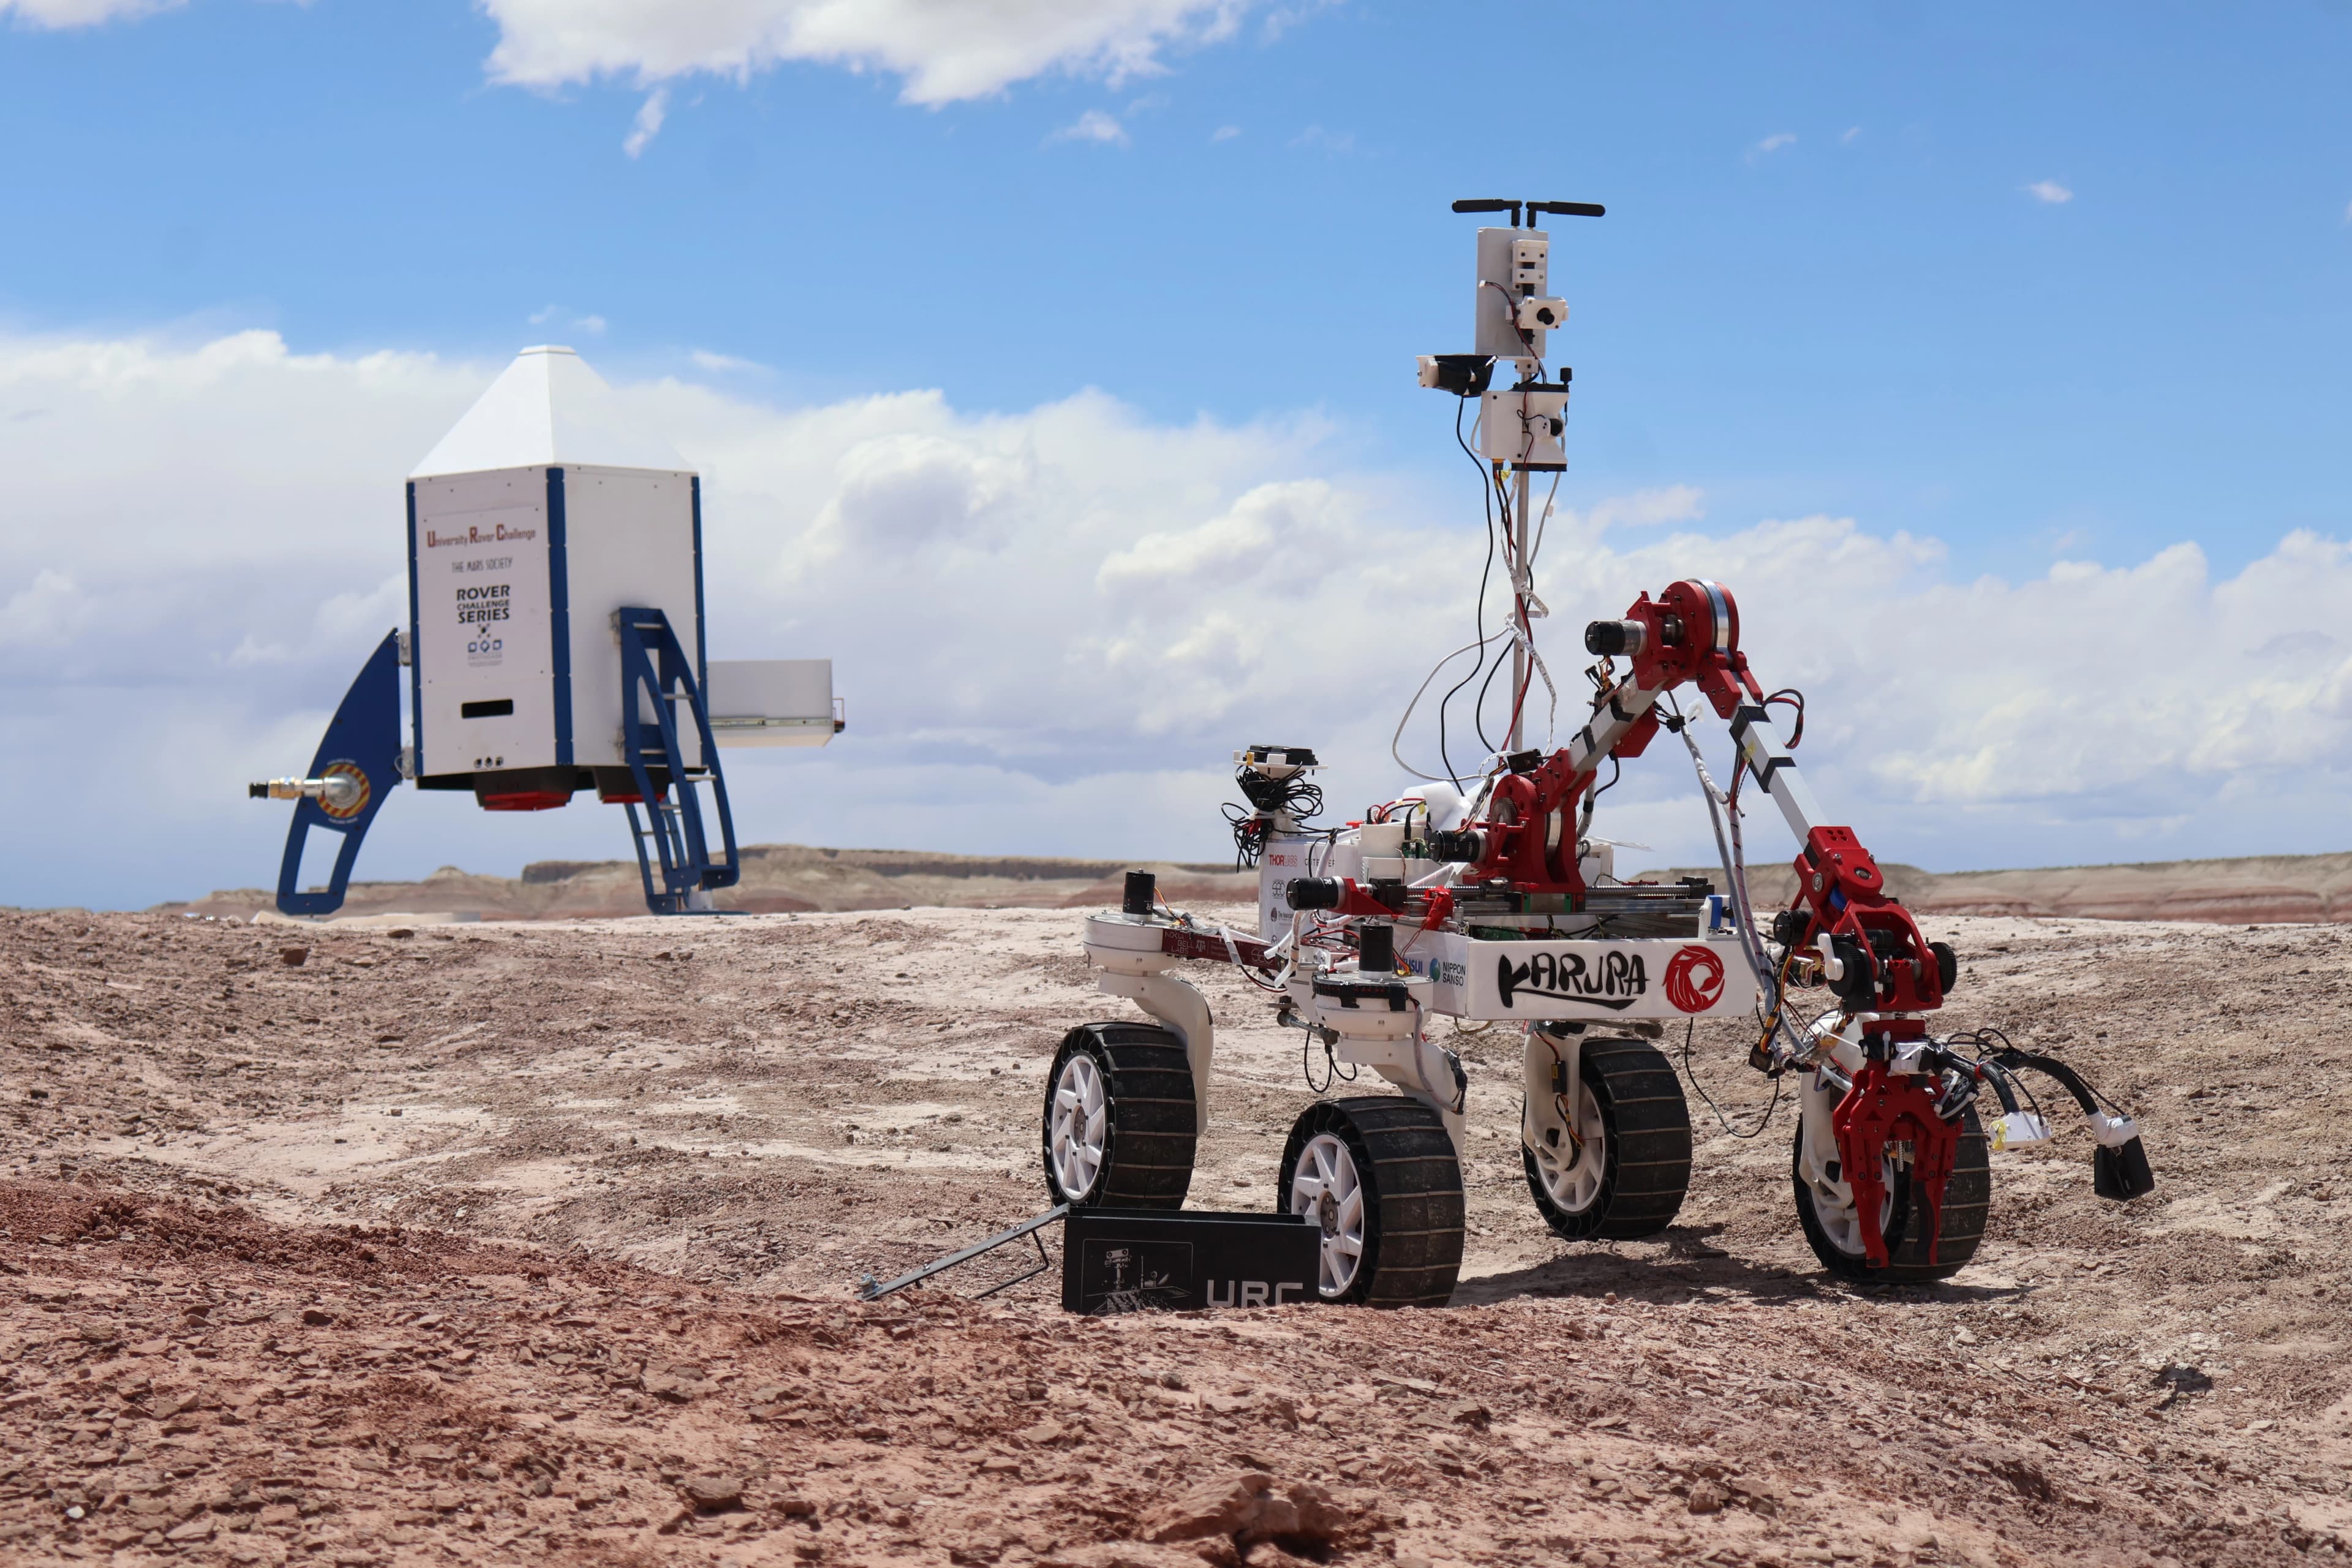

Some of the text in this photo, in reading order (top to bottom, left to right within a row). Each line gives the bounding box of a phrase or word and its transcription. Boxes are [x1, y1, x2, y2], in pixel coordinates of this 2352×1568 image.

[427, 524, 537, 548] University Rover Challenge
[451, 557, 513, 573] THE MARS SOCIETY
[456, 585, 510, 601] ROVER
[456, 599, 510, 611] CHALLENGE
[458, 608, 510, 624] SERIES
[1268, 854, 1298, 867] THORLABS
[1165, 931, 1184, 940] NOKIA
[1171, 945, 1189, 954] LABS
[1177, 940, 1194, 949] BELL
[1442, 961, 1466, 976] NIPPON
[1442, 973, 1464, 987] SANSO
